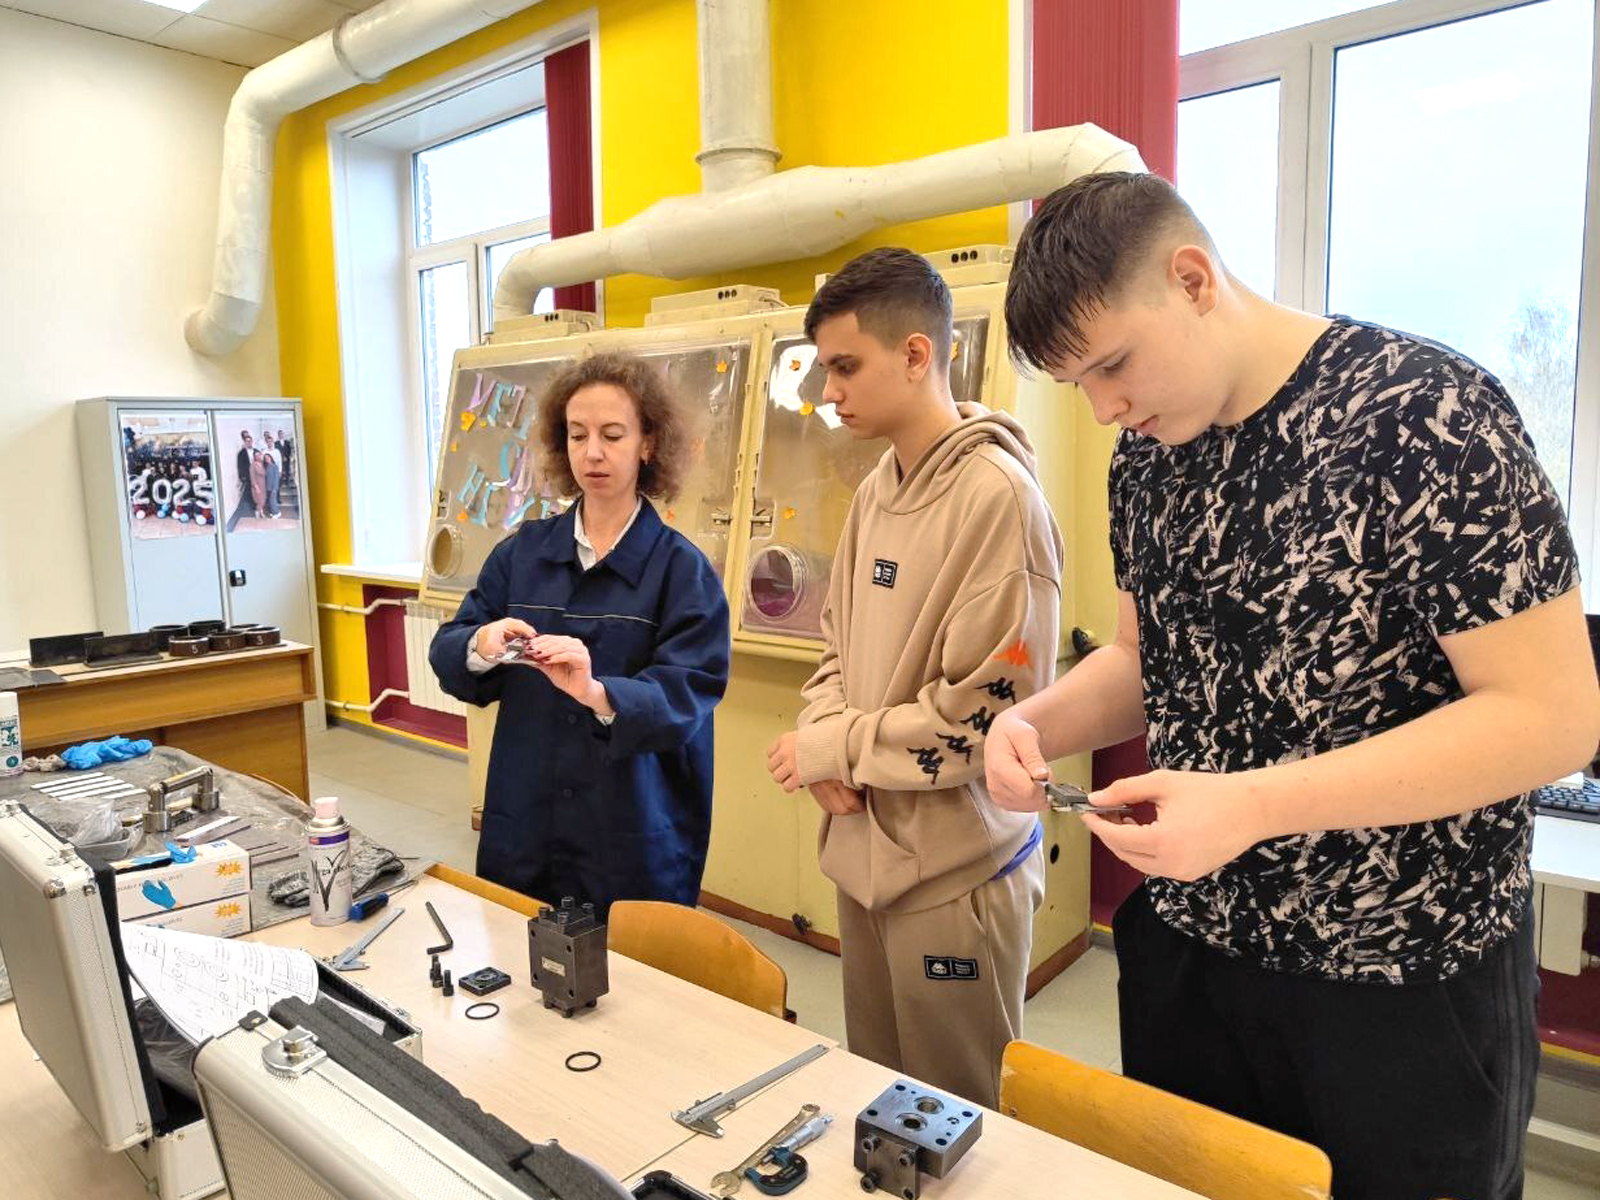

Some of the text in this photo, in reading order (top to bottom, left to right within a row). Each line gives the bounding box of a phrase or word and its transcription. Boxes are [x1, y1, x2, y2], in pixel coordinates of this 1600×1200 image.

[129, 475, 213, 509] 2025
[256, 635, 264, 645] 3
[191, 645, 198, 654] 5
